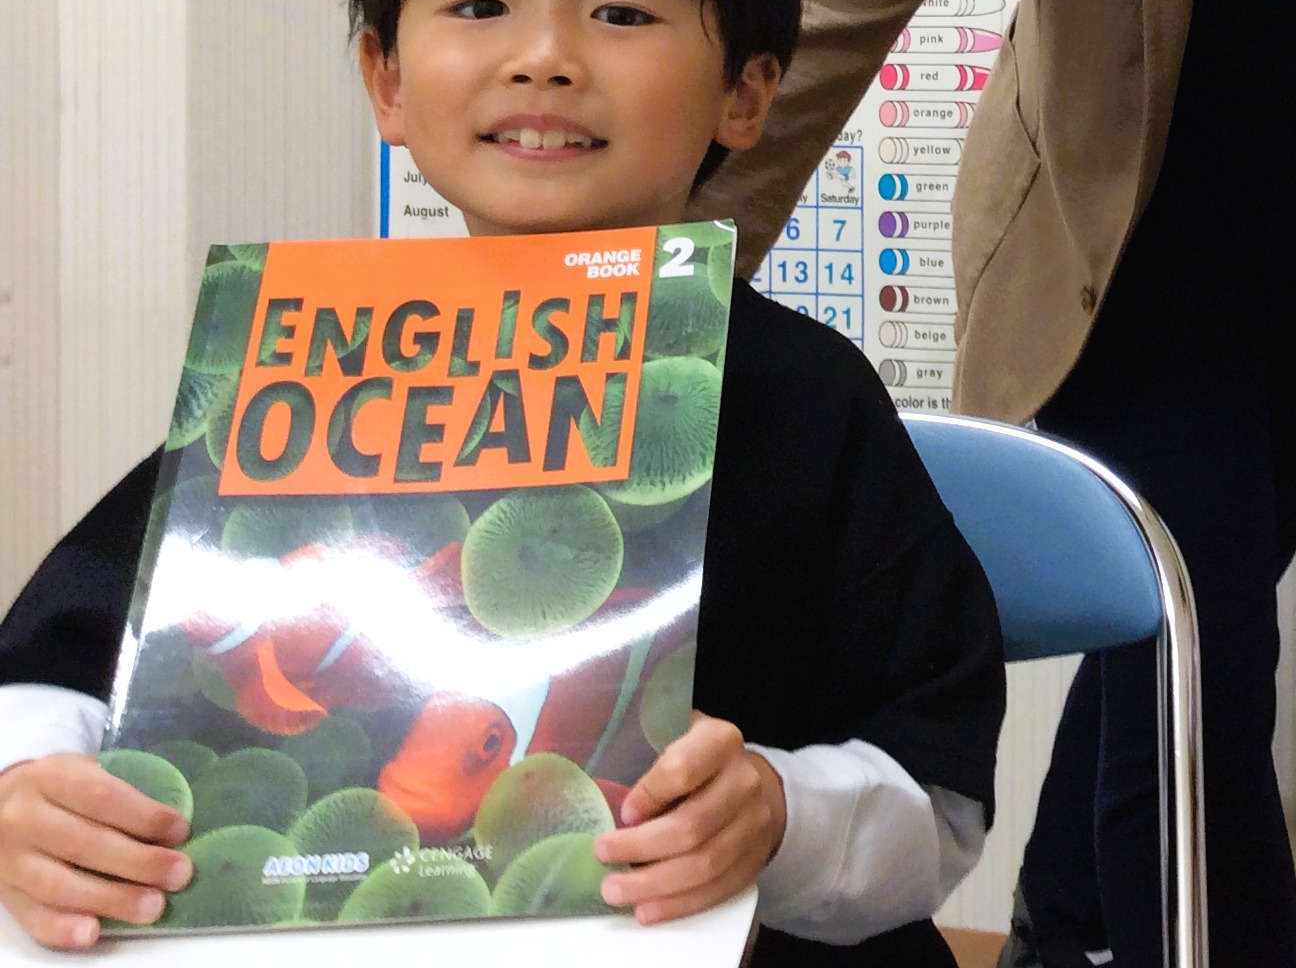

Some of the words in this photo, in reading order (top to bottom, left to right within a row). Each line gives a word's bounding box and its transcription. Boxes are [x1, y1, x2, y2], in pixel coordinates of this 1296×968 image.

[919, 35, 944, 46] pink
[920, 71, 939, 81] red
[913, 108, 954, 120] orange
[913, 145, 951, 157] yellow
[915, 182, 950, 193] green
[820, 193, 860, 206] Saturday
[403, 204, 450, 220] August
[785, 217, 801, 241] 6
[832, 219, 847, 242] 7
[913, 219, 951, 231] purple
[563, 248, 642, 267] ORANGE
[658, 236, 695, 278] 2
[919, 257, 945, 268] blue
[586, 262, 640, 279] BOOK
[777, 260, 809, 284] 13
[824, 262, 855, 285] 14
[913, 294, 950, 305] brown
[823, 306, 851, 330] 21
[255, 289, 639, 378] ENGLISH
[914, 330, 947, 342] beige
[916, 368, 944, 380] gray
[895, 395, 924, 409] color
[927, 396, 938, 410] is
[236, 368, 628, 483] OCEAN
